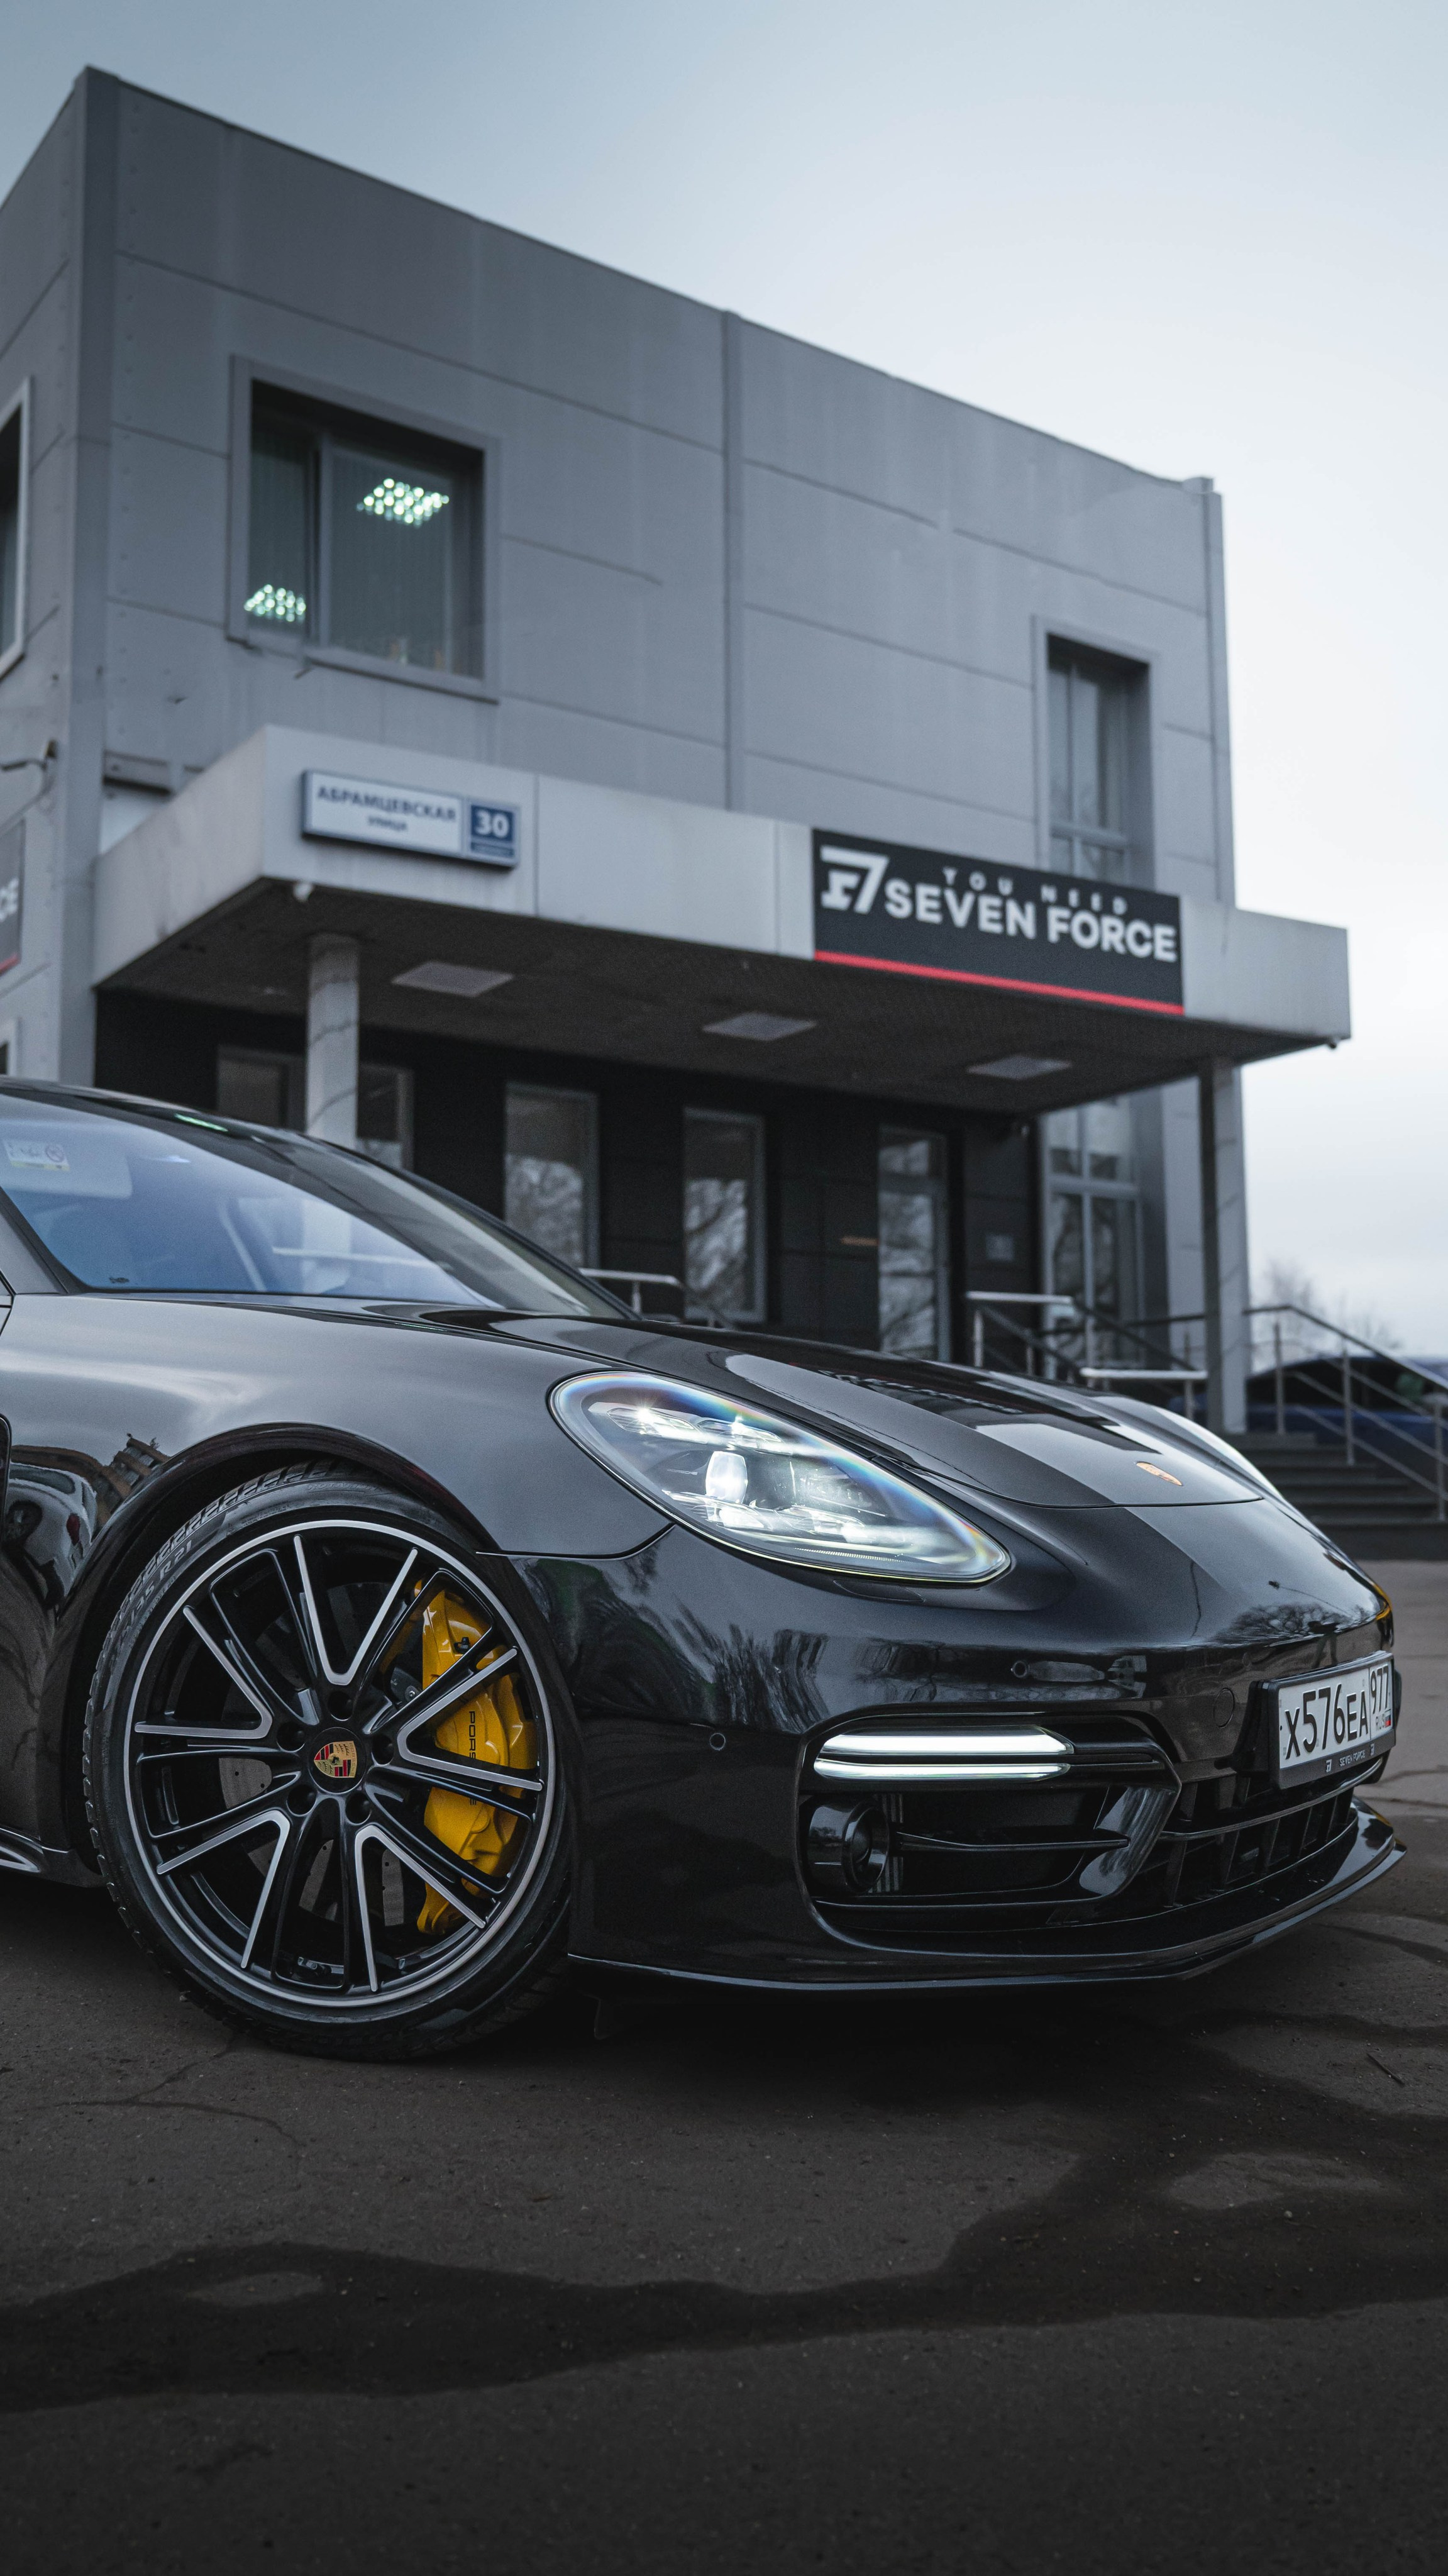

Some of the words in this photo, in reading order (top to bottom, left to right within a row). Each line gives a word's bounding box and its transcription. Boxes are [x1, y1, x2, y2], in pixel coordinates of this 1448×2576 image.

[318, 786, 456, 822] АБРАМЦЕВСКАЯ
[476, 809, 510, 838] 30
[942, 867, 1014, 896] YOU
[1041, 884, 1128, 916] NEED
[884, 879, 1036, 940] SEVEN
[1047, 906, 1178, 963] FORCE
[1371, 1665, 1389, 1714] 977
[1339, 1754, 1353, 1767] SEVEN
